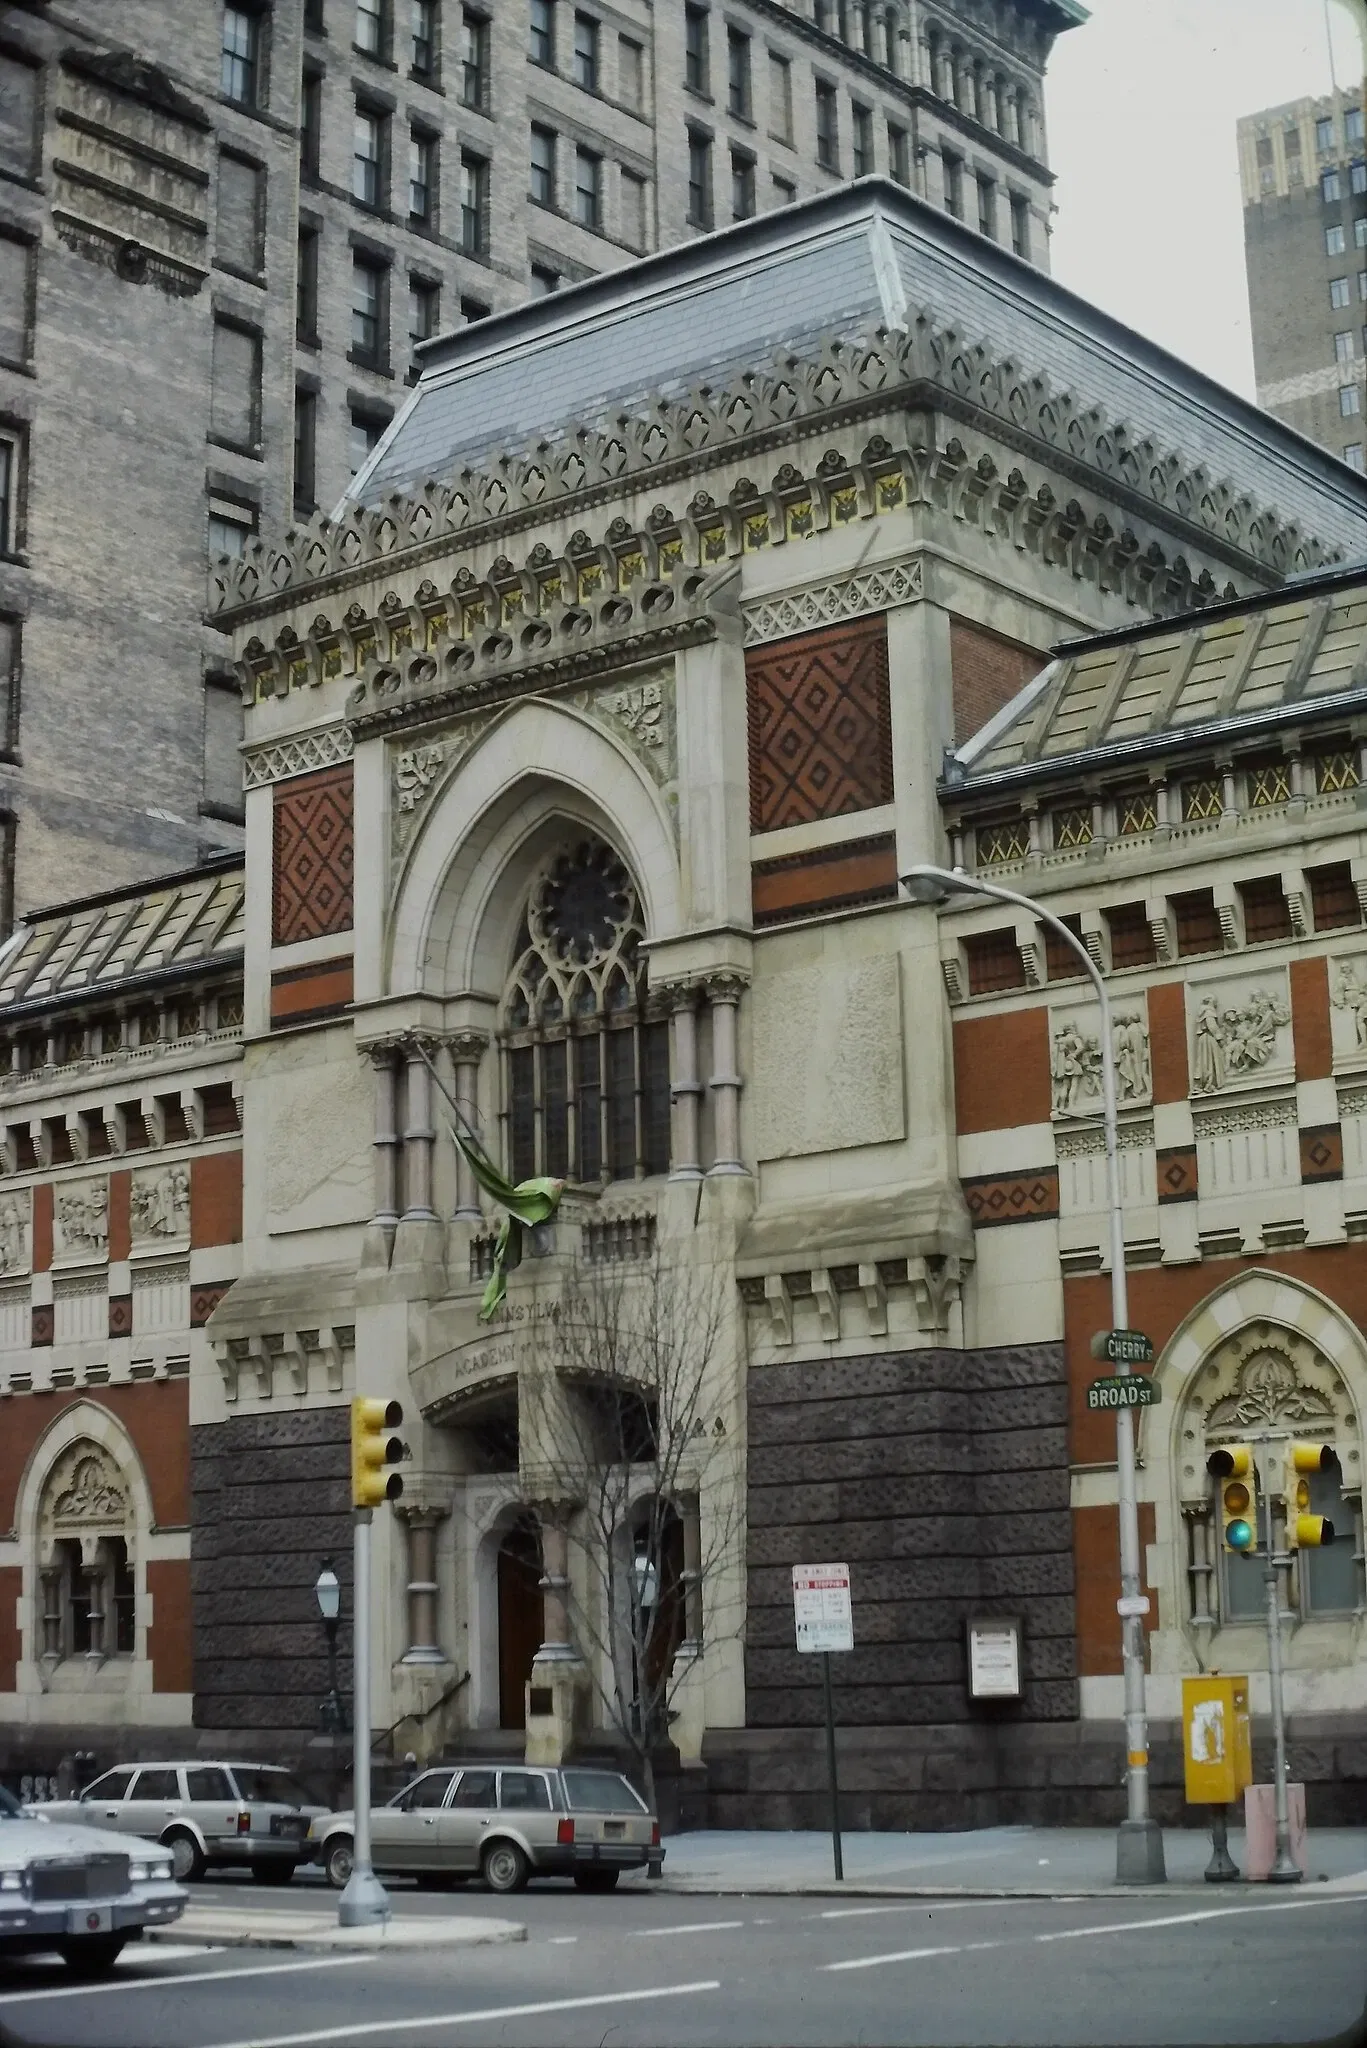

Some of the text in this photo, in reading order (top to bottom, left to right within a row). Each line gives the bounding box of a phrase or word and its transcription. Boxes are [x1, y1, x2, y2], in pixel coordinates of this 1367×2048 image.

[1108, 1339, 1145, 1360] CHERRY
[455, 1344, 515, 1379] ACADEMY
[1089, 1387, 1151, 1408] BROAD ST
